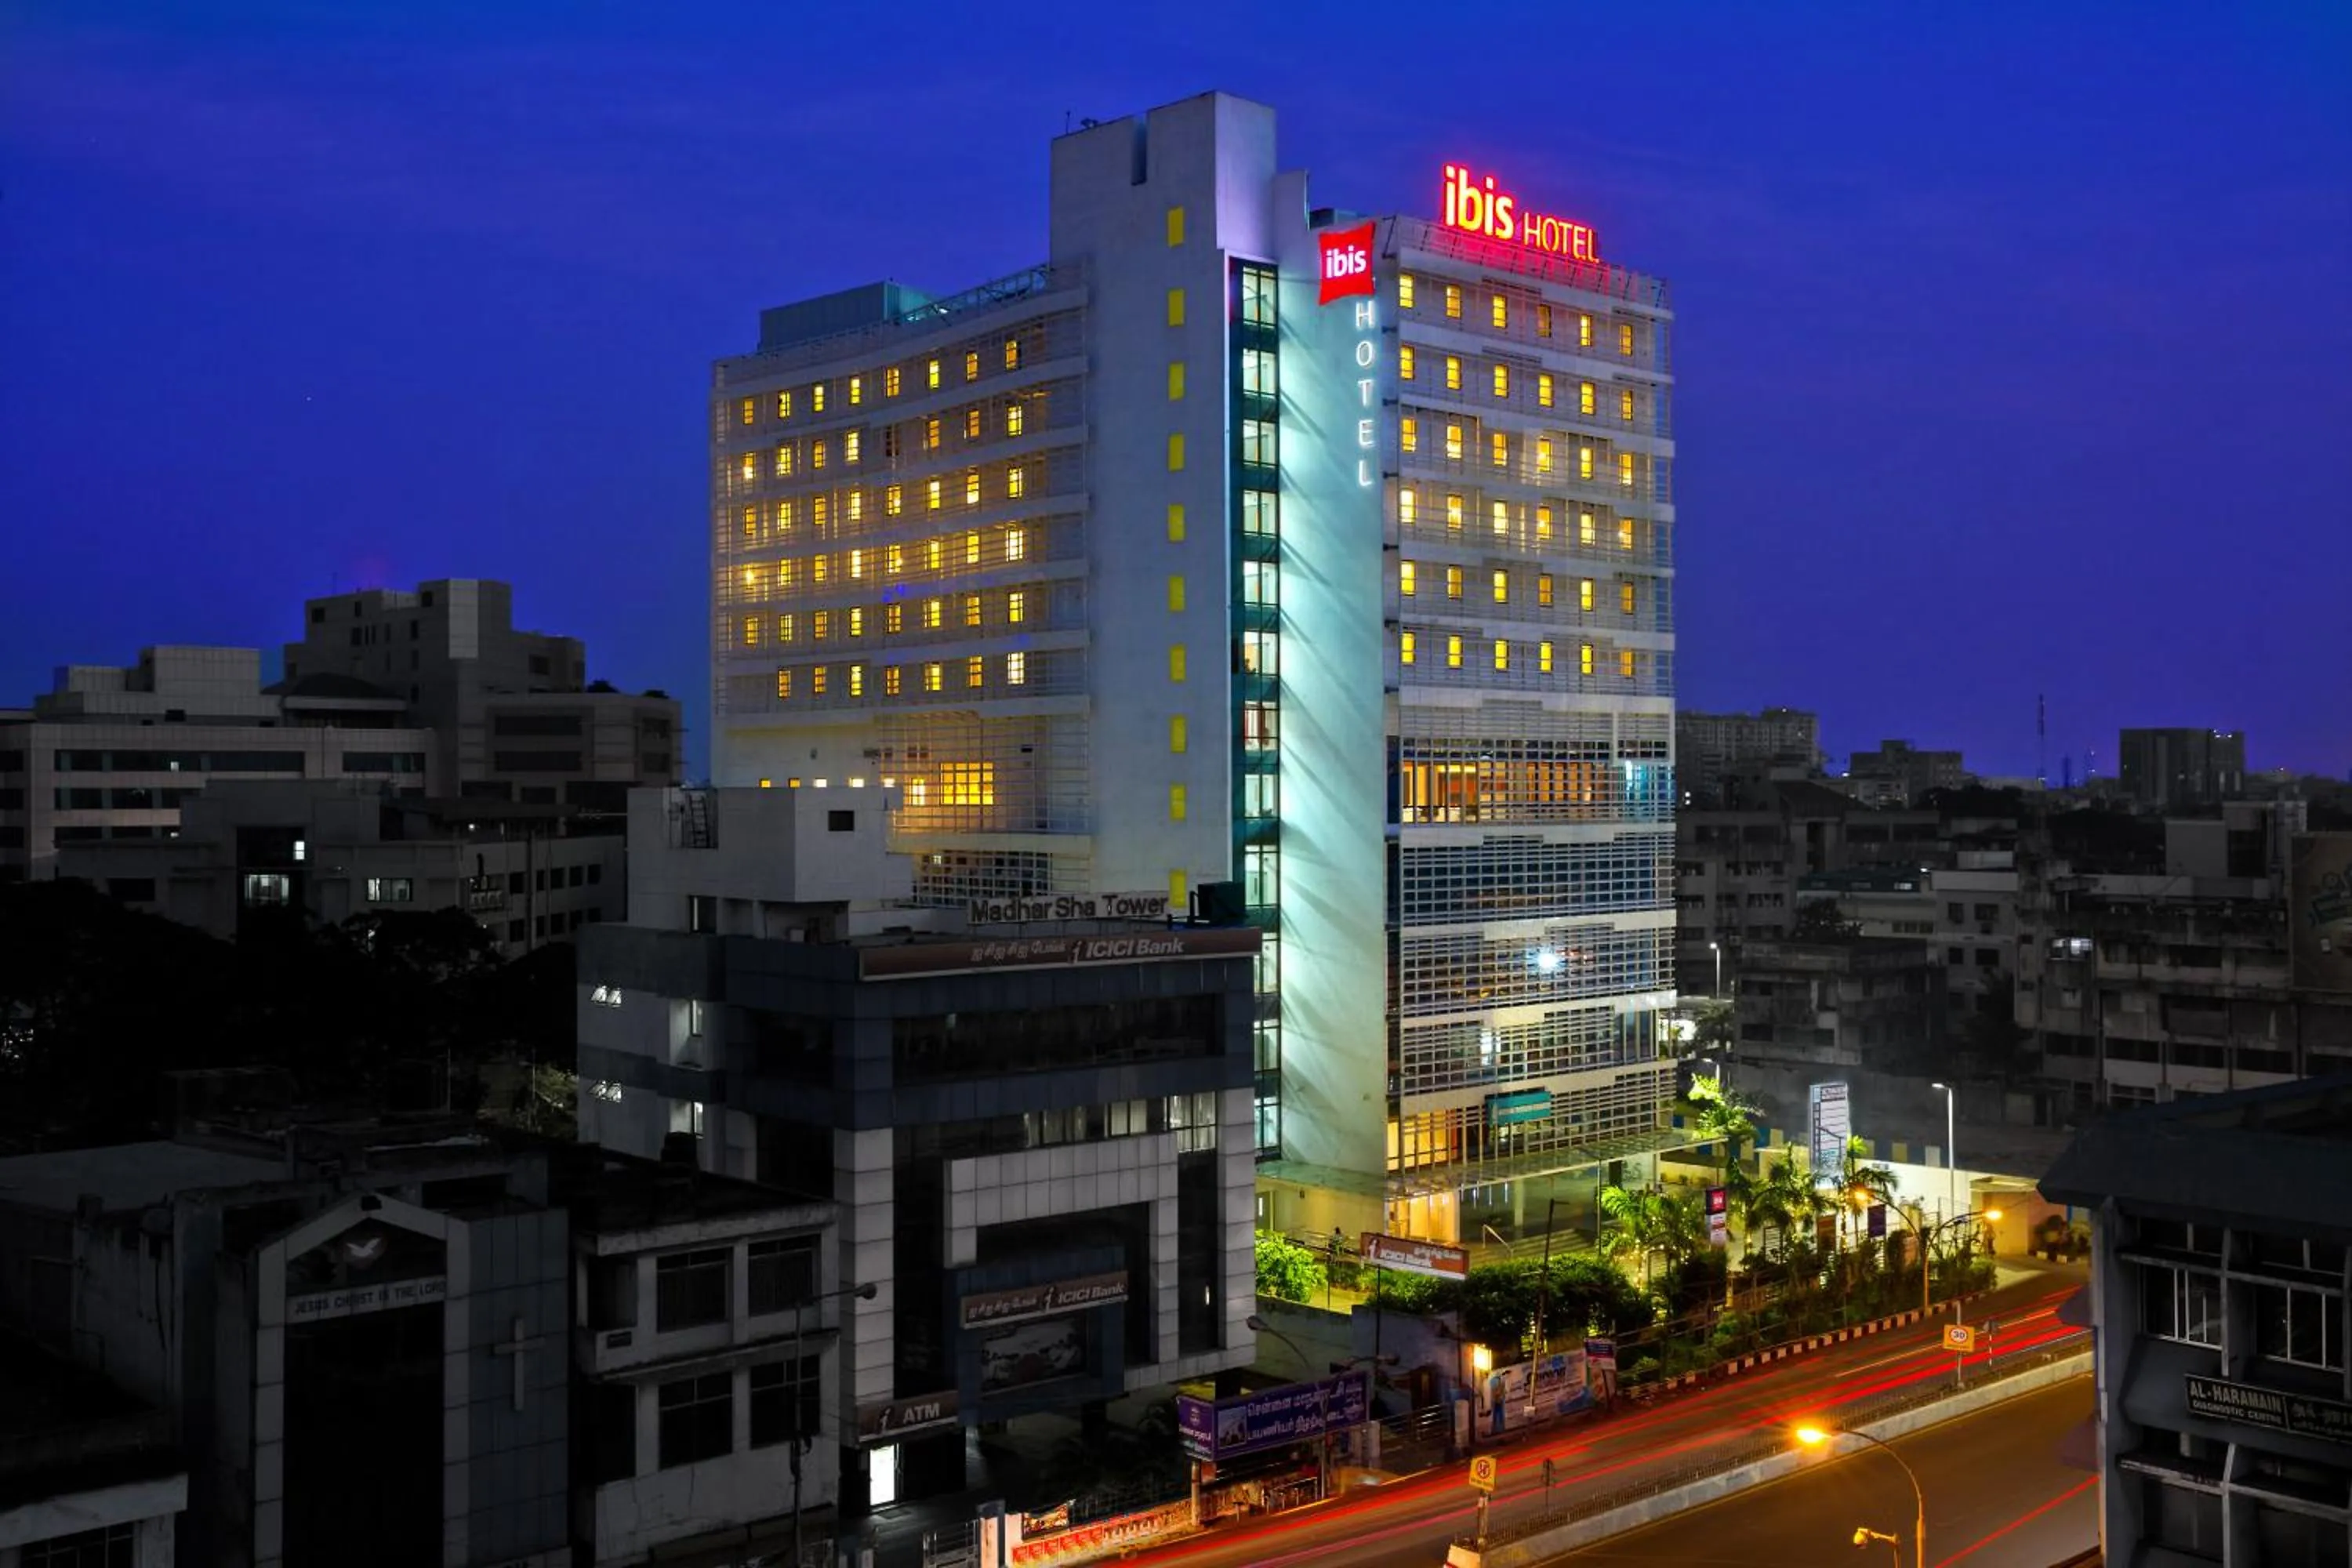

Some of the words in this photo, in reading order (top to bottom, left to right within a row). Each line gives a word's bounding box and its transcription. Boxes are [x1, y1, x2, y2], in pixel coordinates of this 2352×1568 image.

[1443, 164, 1515, 240] ibis
[1523, 212, 1599, 263] HOTEL
[1325, 245, 1367, 281] ibis
[1355, 300, 1375, 488] HOTEL
[1055, 895, 1097, 918] Sha
[1102, 895, 1169, 916] Tower
[1086, 940, 1134, 959] ICICI
[1136, 937, 1185, 956] Bank
[296, 1296, 328, 1316] JESUS
[334, 1291, 373, 1308] CHRIST
[379, 1289, 390, 1301] IS
[394, 1286, 416, 1300] THE
[1058, 1288, 1090, 1305] ICICI
[1091, 1282, 1126, 1298] Bank
[1953, 1330, 1965, 1340] 30
[902, 1402, 941, 1425] ATM
